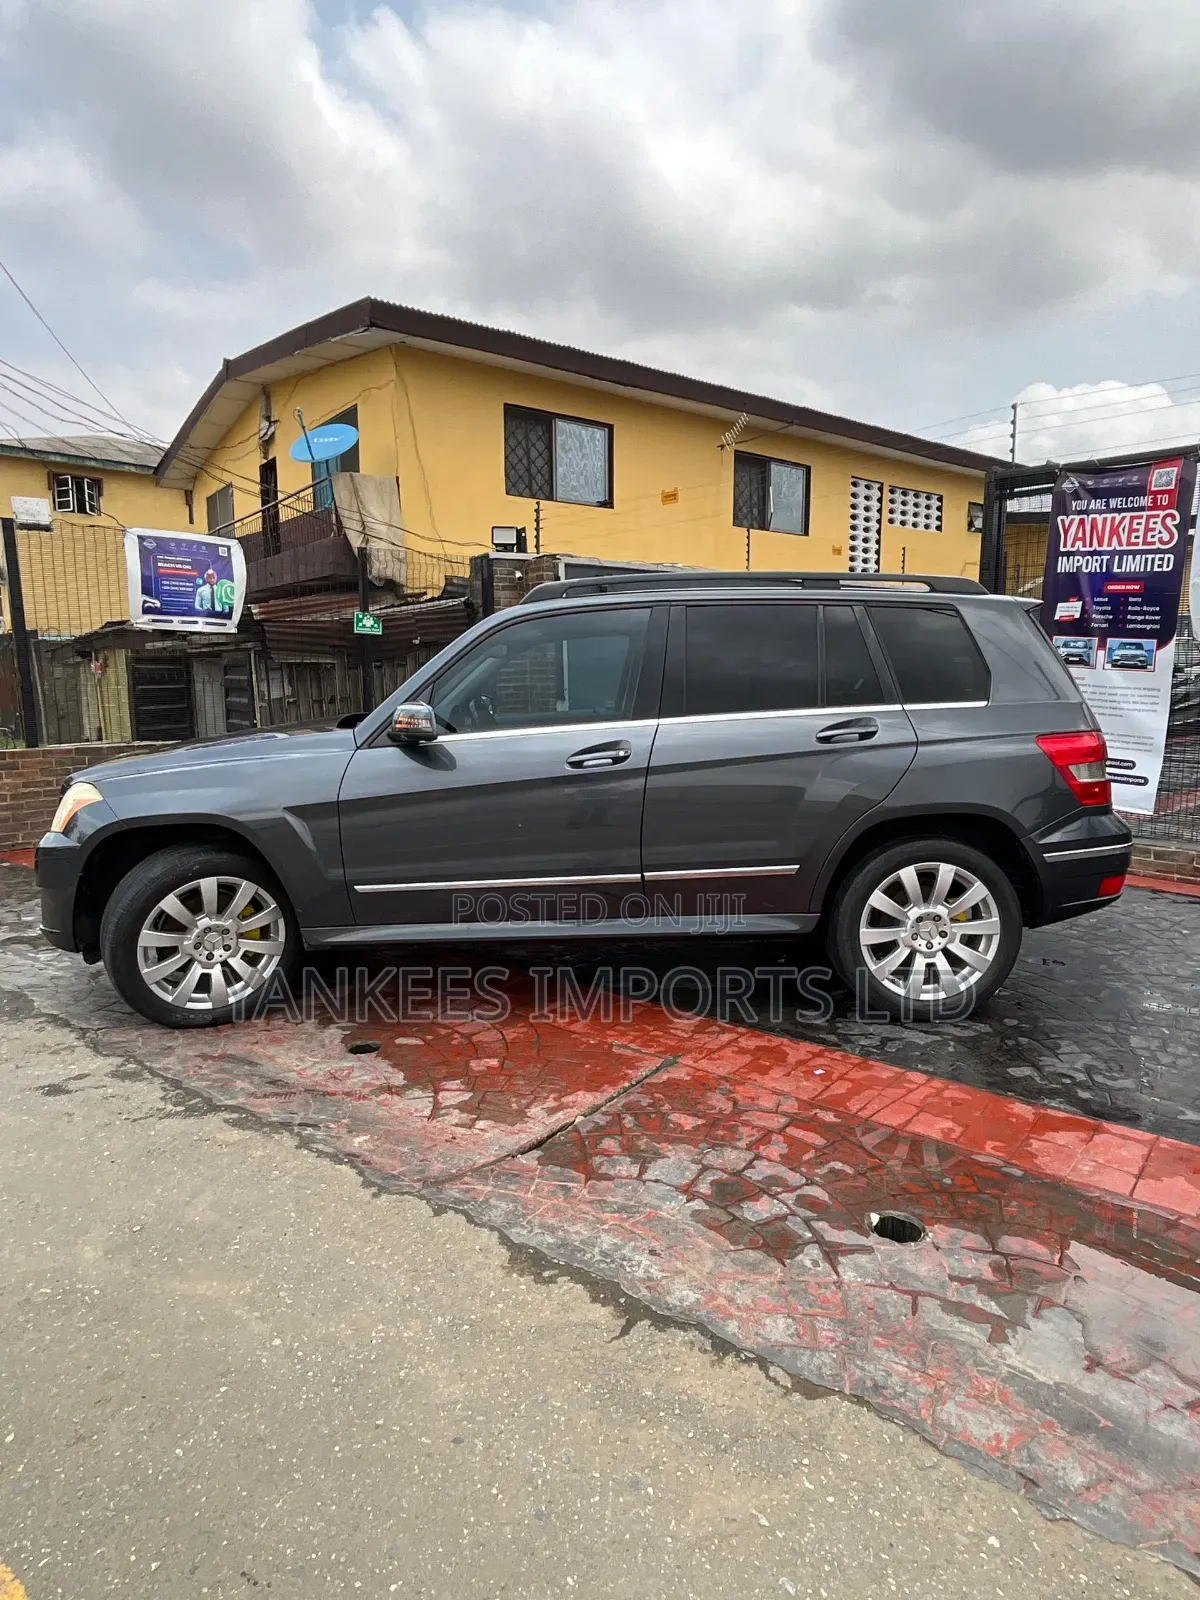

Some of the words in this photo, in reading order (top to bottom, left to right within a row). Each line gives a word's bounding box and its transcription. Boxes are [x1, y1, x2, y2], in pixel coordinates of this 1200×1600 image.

[1071, 500, 1088, 511] YOU
[1089, 498, 1107, 510] ARE
[1109, 495, 1154, 509] WELCOME
[1156, 494, 1169, 506] TO
[1057, 509, 1180, 552] YANKEES
[1057, 555, 1110, 573] IMPORT
[1112, 553, 1175, 573] LIMITED
